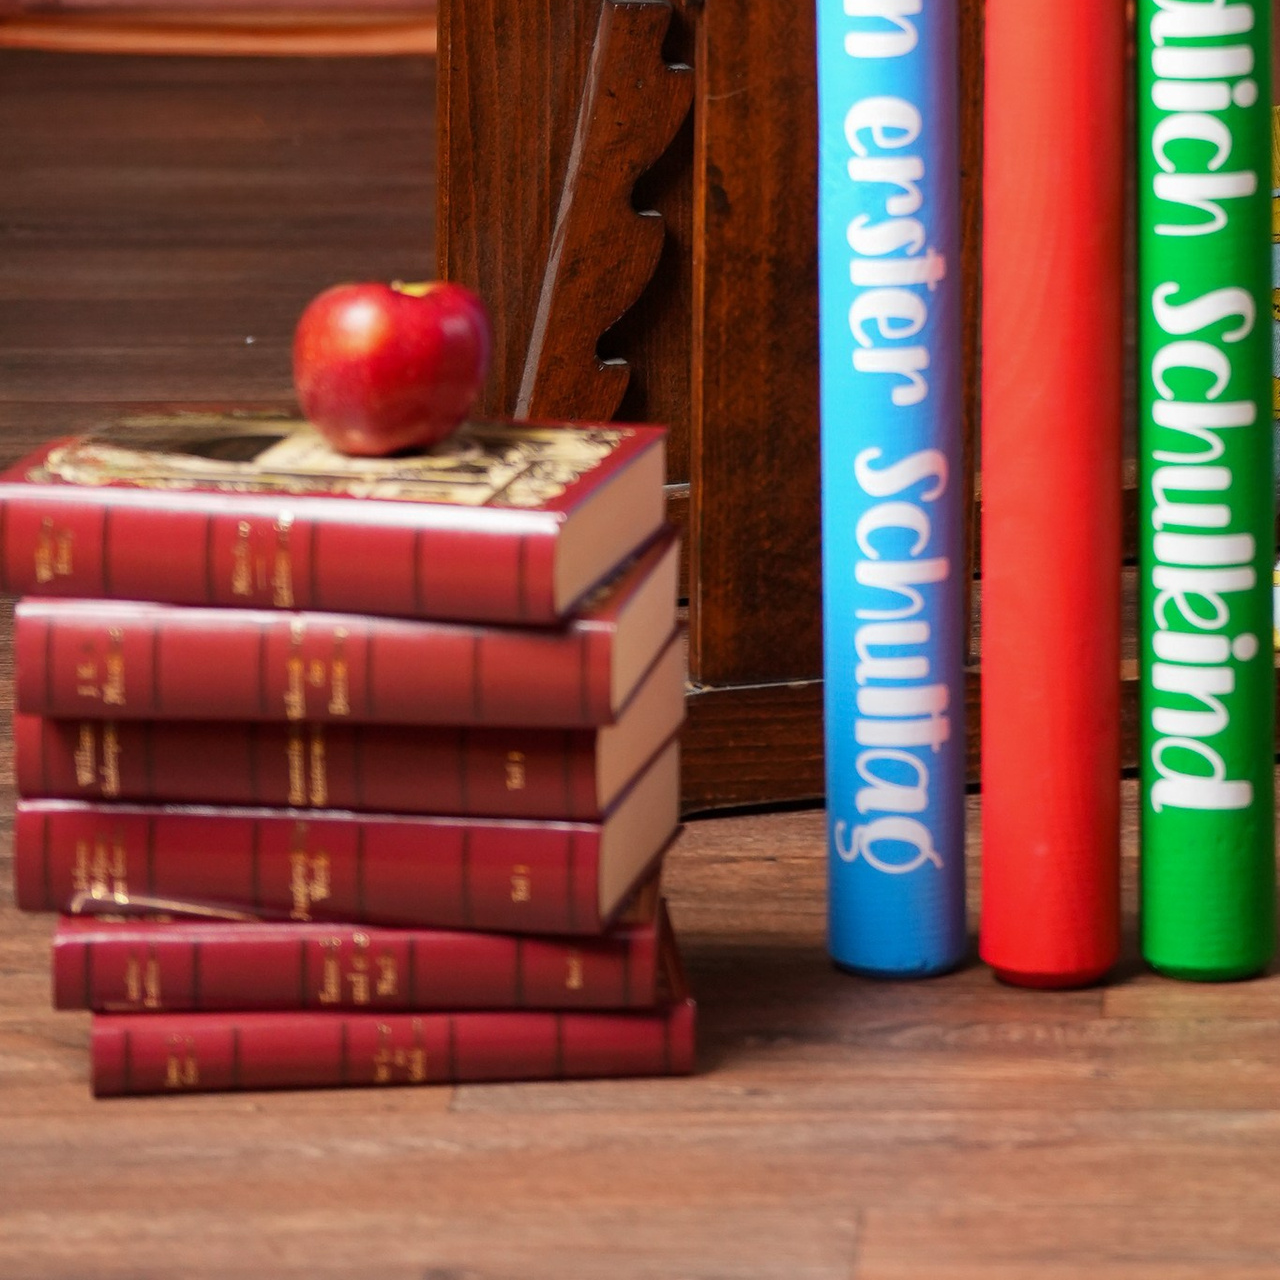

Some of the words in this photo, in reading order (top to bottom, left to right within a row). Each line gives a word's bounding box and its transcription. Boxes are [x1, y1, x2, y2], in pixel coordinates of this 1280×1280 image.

[844, 93, 948, 409] erster
[833, 443, 951, 876] Schultag
[1150, 279, 1260, 813] Schulkind
